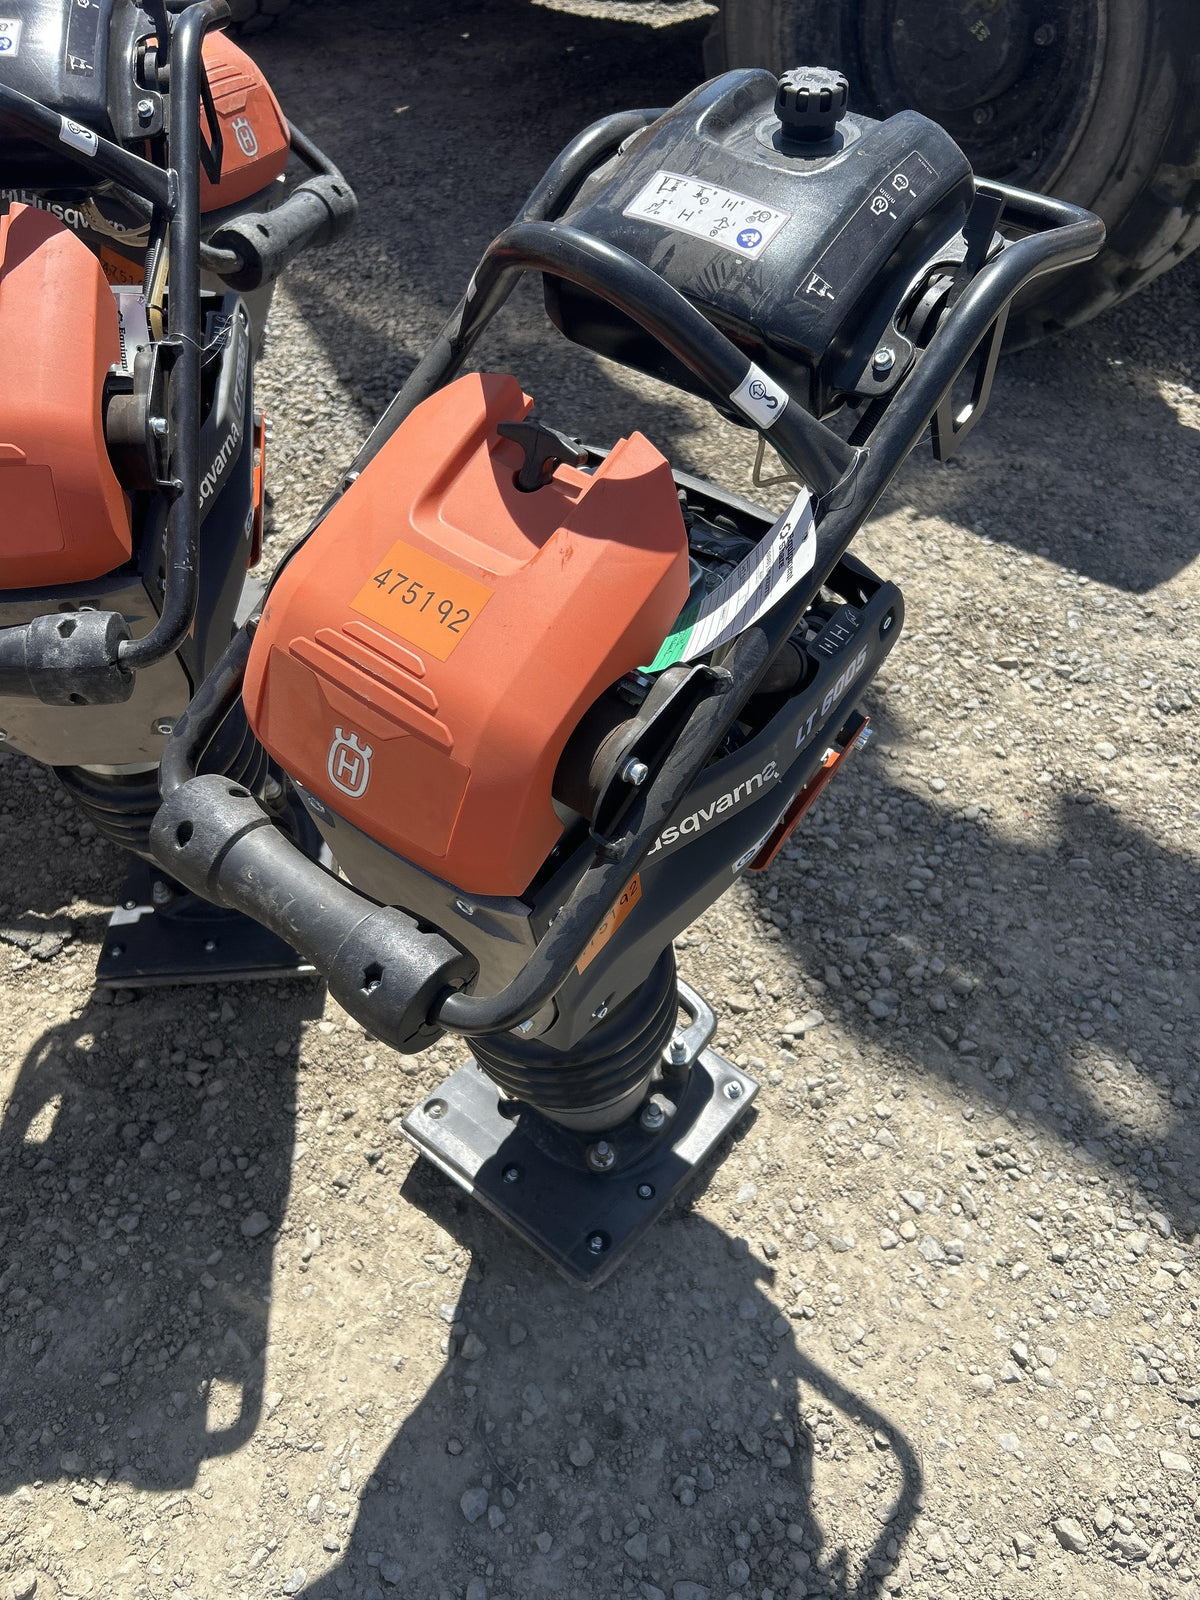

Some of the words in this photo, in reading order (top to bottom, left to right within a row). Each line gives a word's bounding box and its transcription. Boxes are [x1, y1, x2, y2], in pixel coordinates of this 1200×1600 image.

[373, 568, 470, 634] 475192
[795, 708, 818, 749] LT
[821, 643, 869, 716] 6005
